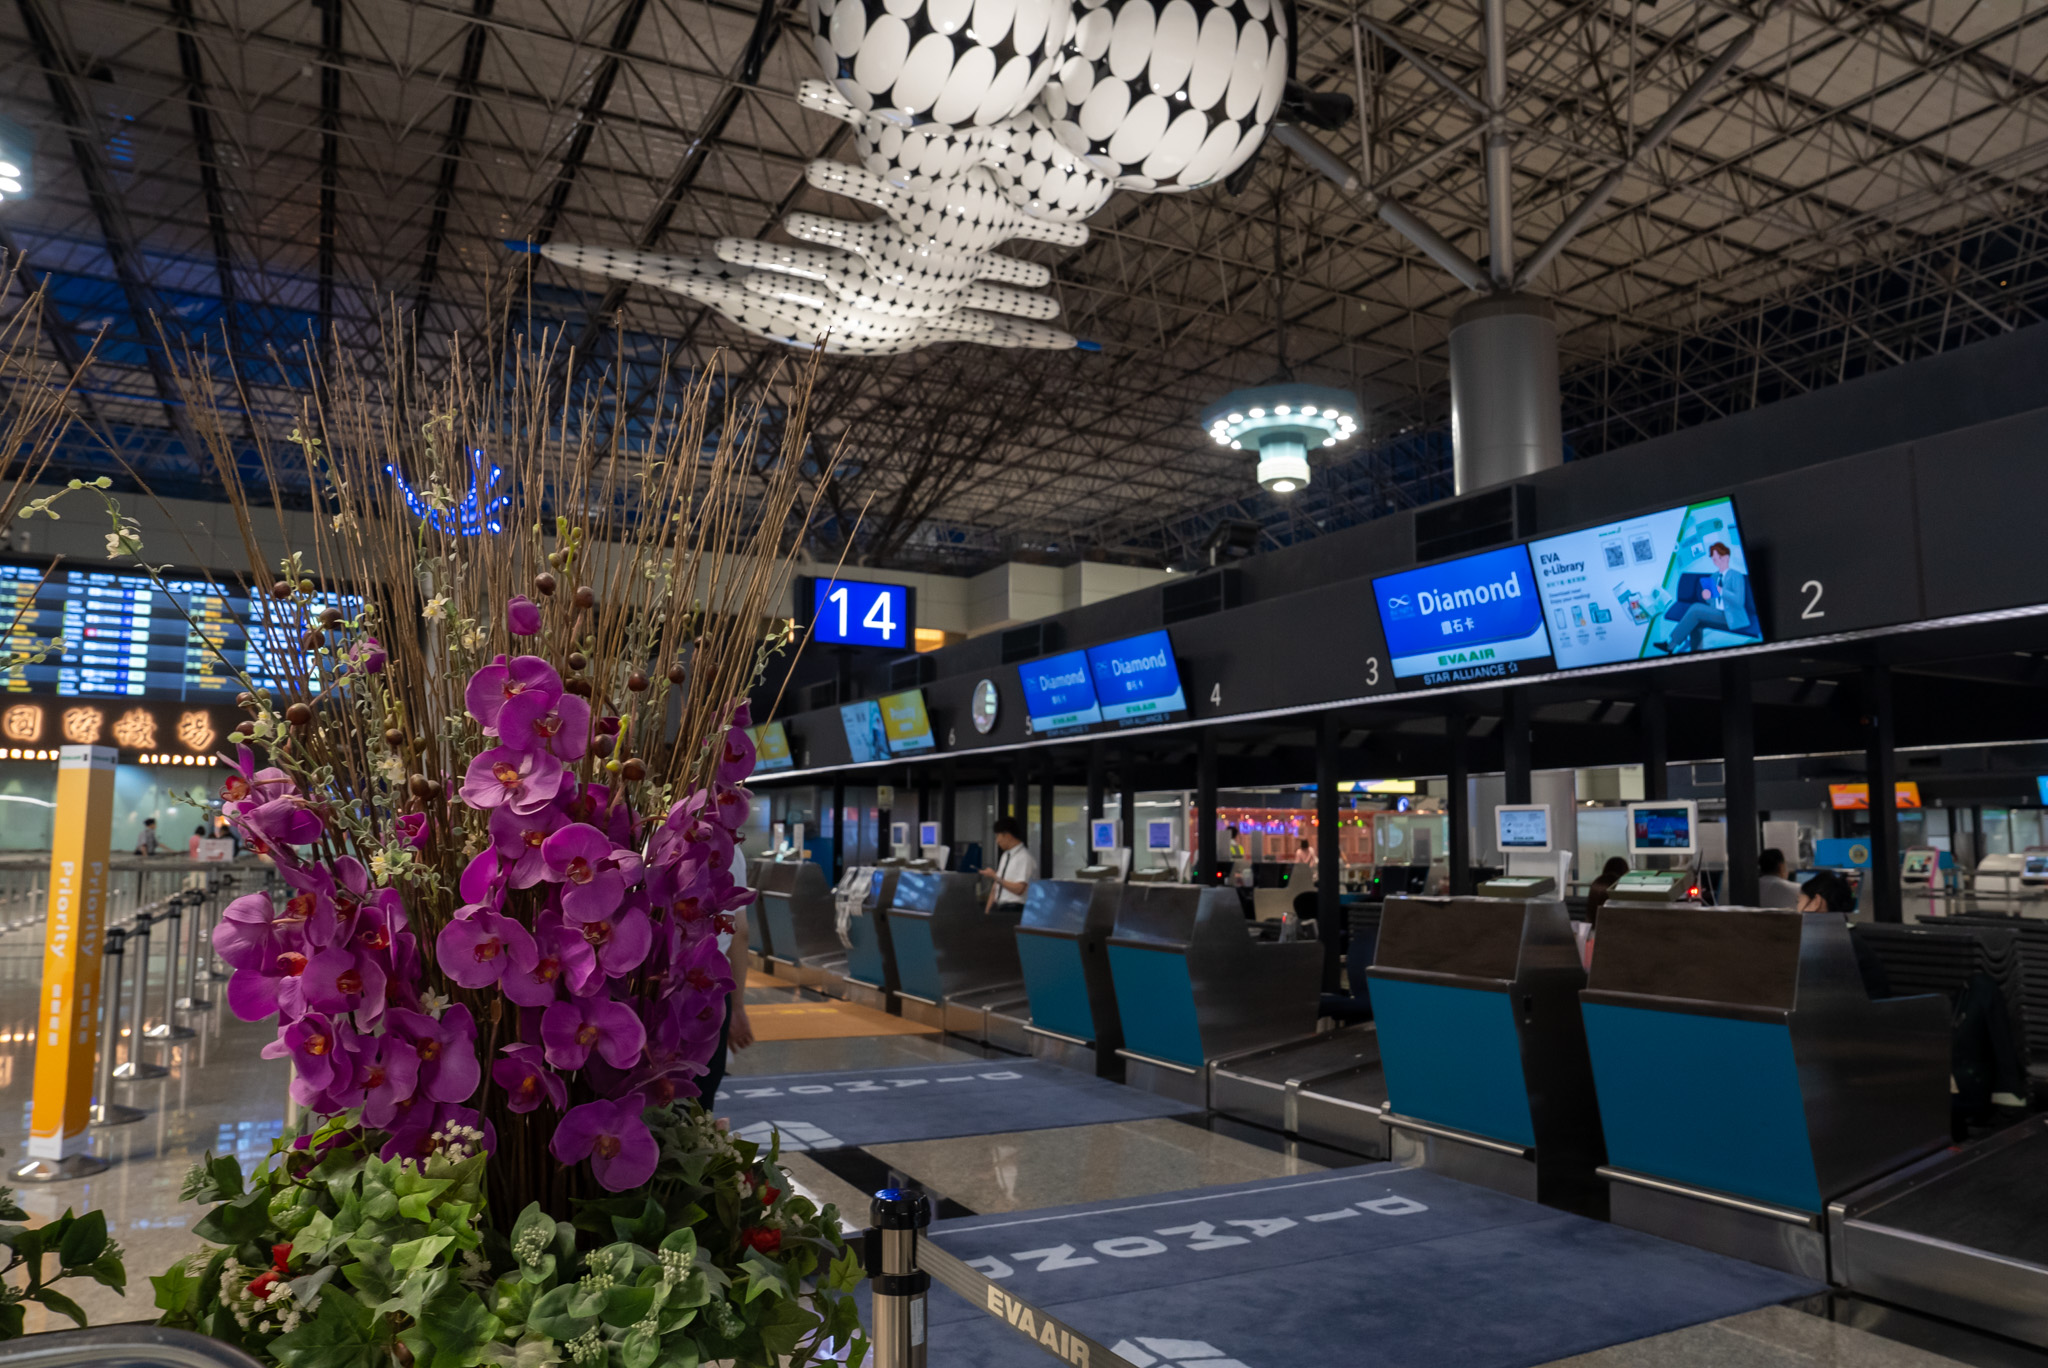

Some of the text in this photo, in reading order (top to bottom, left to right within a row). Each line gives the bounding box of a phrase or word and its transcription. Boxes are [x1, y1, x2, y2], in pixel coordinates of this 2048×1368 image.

[1540, 552, 1560, 565] EVA
[1543, 561, 1585, 577] e-Library
[1417, 571, 1521, 616] Diamond
[1801, 580, 1825, 619] 2
[829, 587, 897, 640] 14
[1111, 648, 1167, 676] Diamond
[1438, 648, 1495, 666] EVA AIR
[1039, 667, 1086, 691] Diamond
[1366, 656, 1379, 686] 3
[1423, 663, 1507, 686] STAR ALLIANCE
[1210, 682, 1221, 706] 4
[948, 727, 956, 746] 6
[1025, 716, 1033, 736] 5
[51, 861, 75, 958] Priority
[81, 861, 103, 957] Priority
[987, 1284, 1090, 1368] EVA AIR
